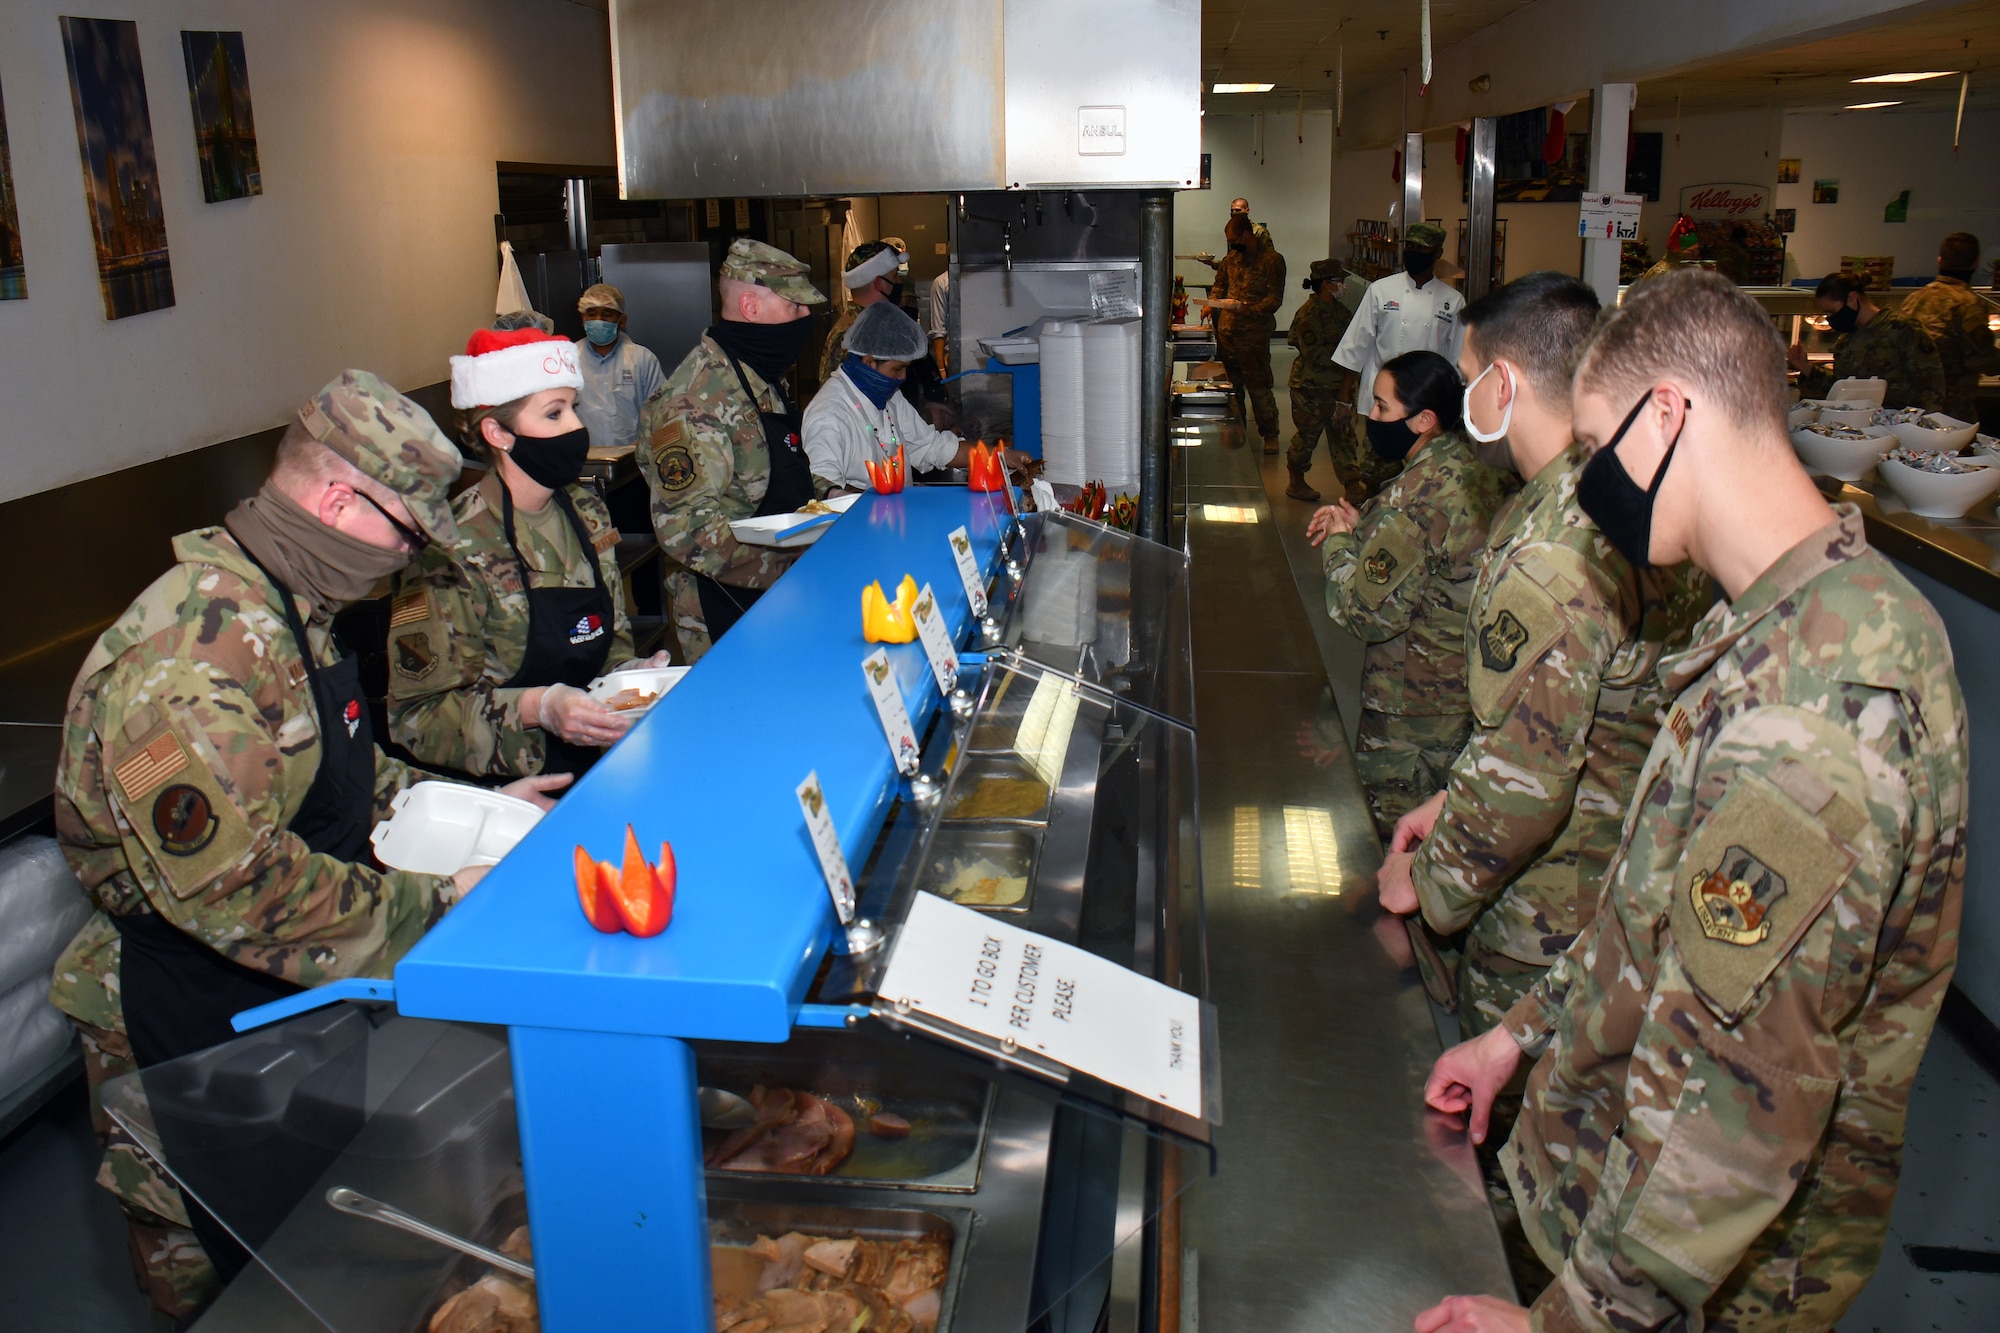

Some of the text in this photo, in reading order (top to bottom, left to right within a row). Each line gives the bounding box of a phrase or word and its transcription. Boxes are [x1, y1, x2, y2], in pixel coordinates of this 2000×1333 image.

[1082, 124, 1123, 137] ANSUL
[1689, 188, 1763, 214] Kellogg's
[968, 936, 1001, 1008] 1 TO GO BOX
[1009, 944, 1042, 1030] PER CUSTOMER
